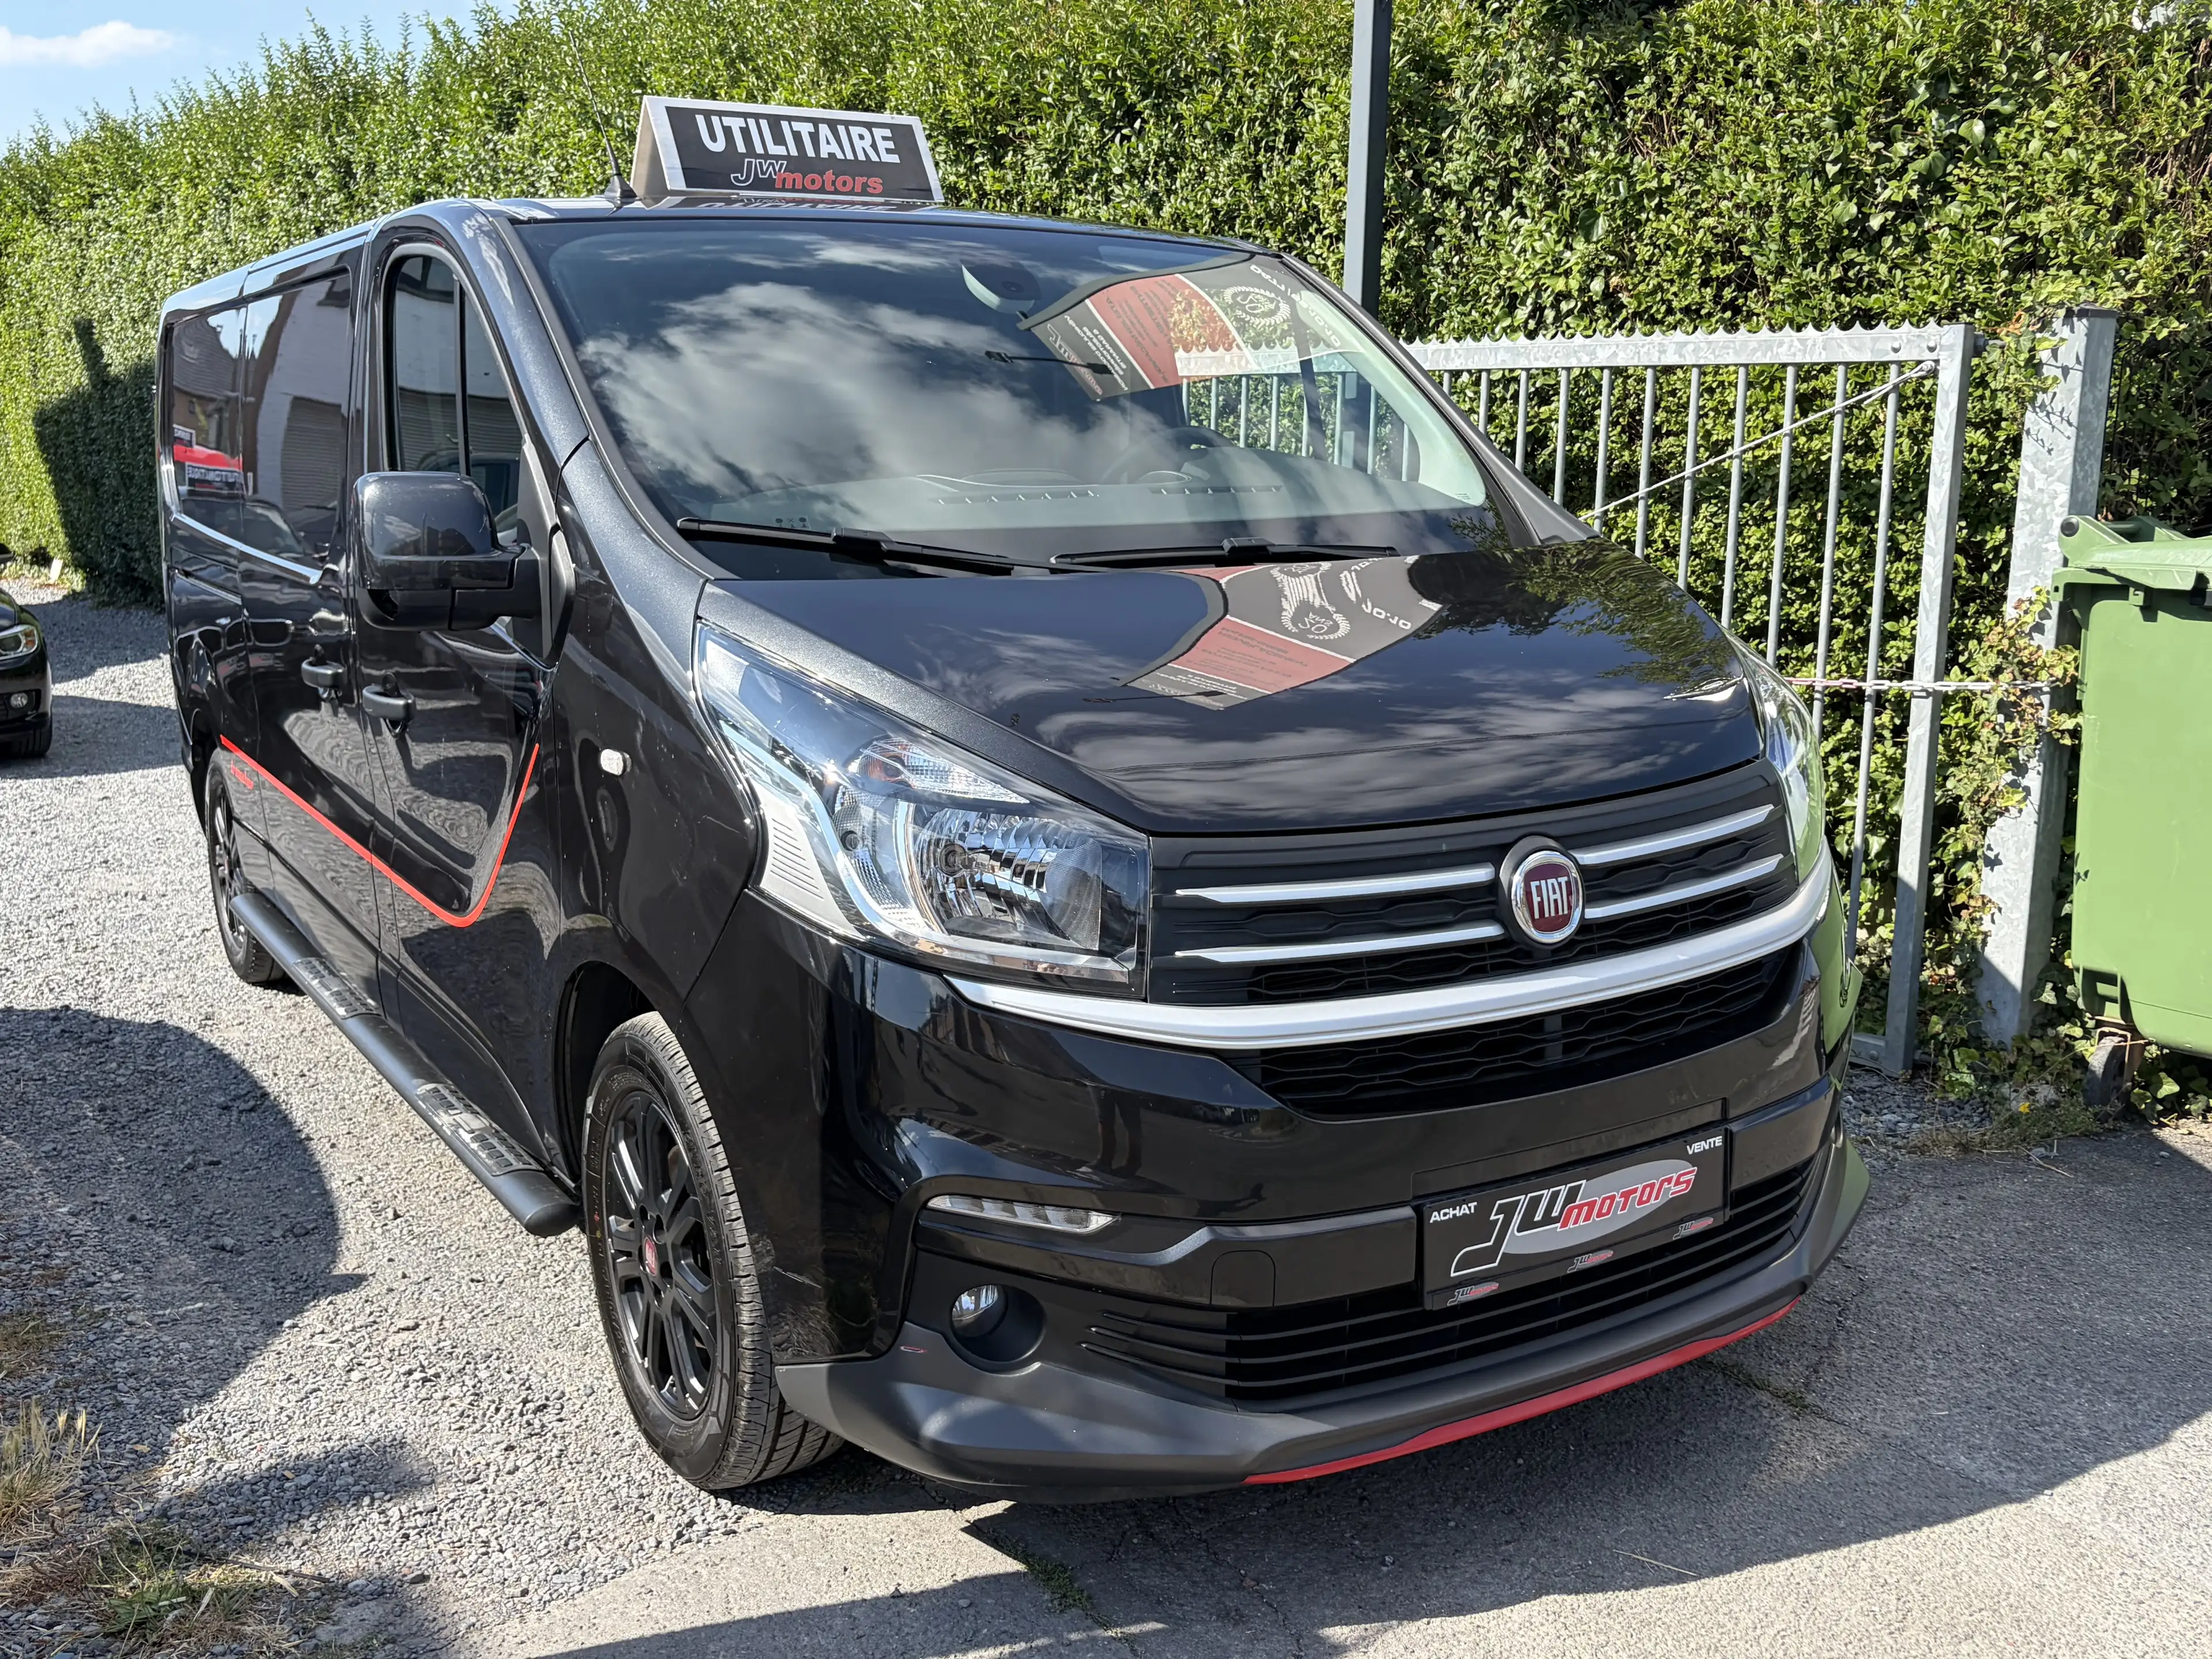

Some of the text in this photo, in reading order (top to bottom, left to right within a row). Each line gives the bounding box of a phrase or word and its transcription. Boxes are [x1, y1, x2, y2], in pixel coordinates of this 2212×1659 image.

[695, 113, 901, 164] UTILITAIRE
[730, 158, 884, 194] JW motors
[1530, 876, 1569, 919] FIAT
[1686, 1135, 1723, 1155] VENTE
[1429, 1201, 1478, 1224] ACHAT
[1450, 1179, 1586, 1277] JW
